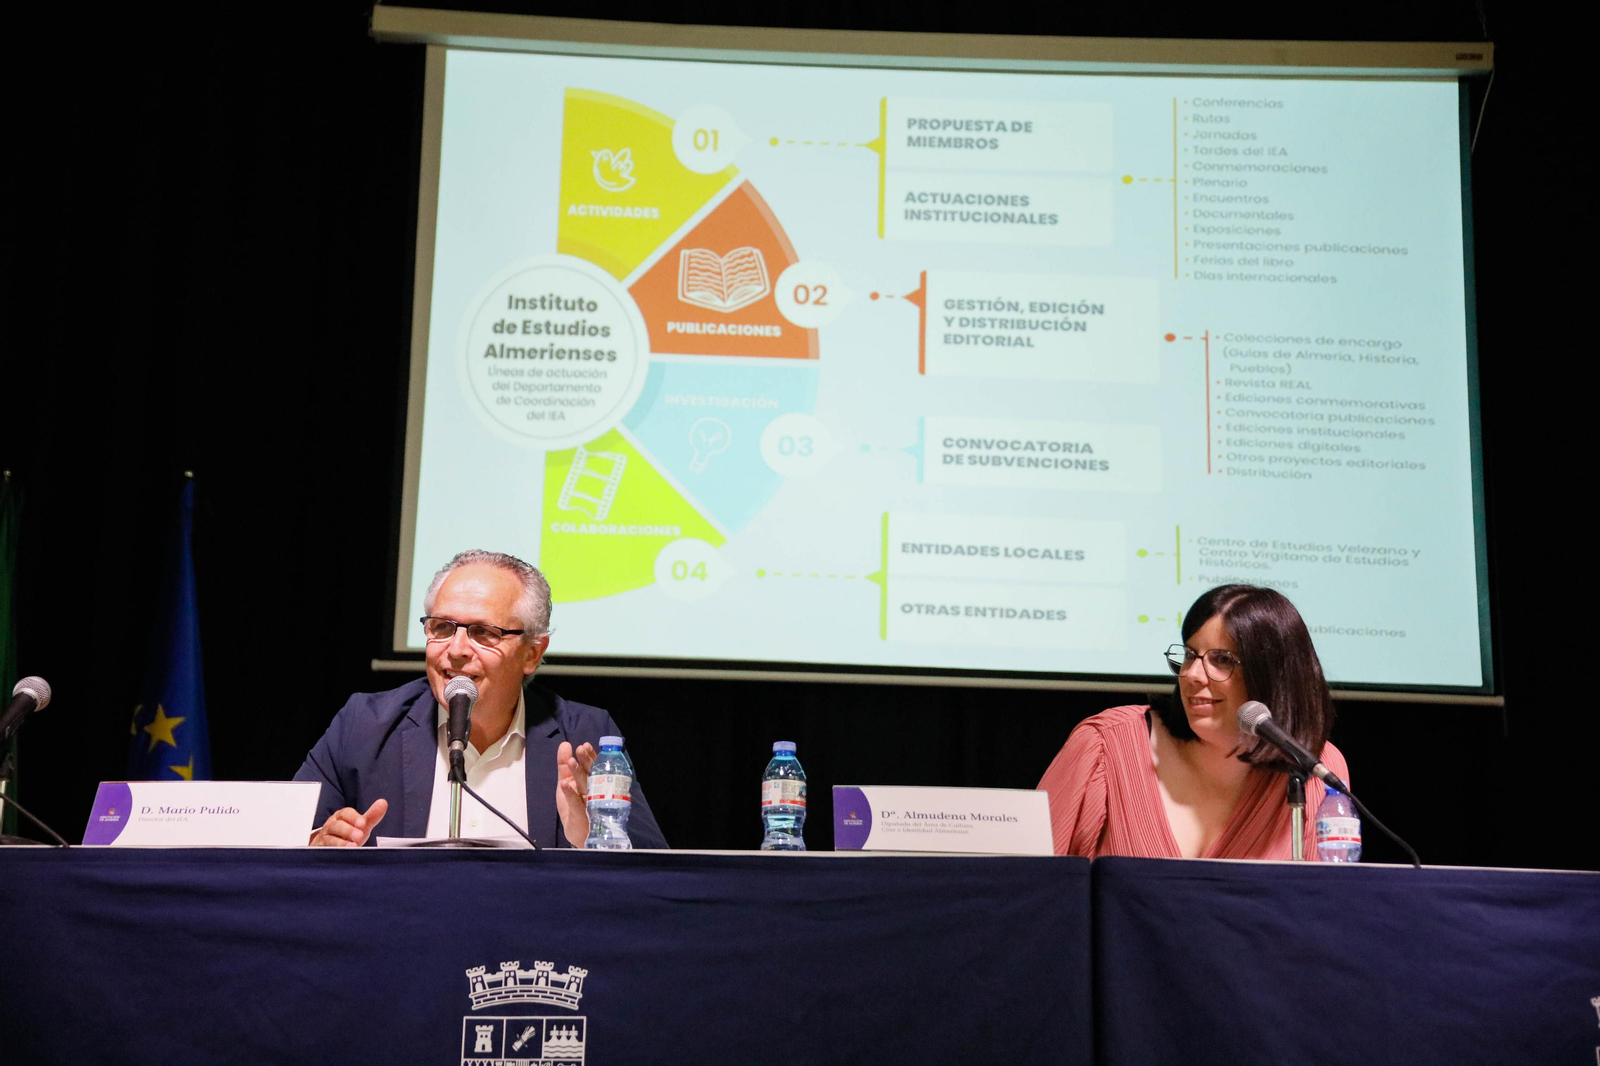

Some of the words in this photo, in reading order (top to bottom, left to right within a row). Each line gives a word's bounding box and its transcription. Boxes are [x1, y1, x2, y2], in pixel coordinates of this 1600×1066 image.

[1192, 98, 1284, 109] Conferencias
[907, 117, 1008, 133] PROPUESTA
[1011, 121, 1033, 133] DE
[1192, 114, 1230, 124] Rutas
[693, 129, 719, 151] 01
[907, 136, 999, 150] MIEMBROS
[1192, 130, 1257, 141] Jornadas
[1192, 146, 1239, 156] Tardes
[1243, 146, 1264, 156] del
[1267, 147, 1288, 156] IEA
[1192, 162, 1328, 174] Conmemoraciones
[1193, 177, 1247, 188] Plenario
[904, 192, 1030, 207] ACTUACIONES
[1193, 193, 1269, 204] Encuentros
[568, 204, 660, 219] ACTIVIDADES
[904, 209, 1059, 225] INSTITUCIONALES
[1193, 209, 1295, 221] Documentales
[1193, 225, 1281, 236] Exposiciones
[1193, 240, 1300, 253] Presentaciones
[1304, 242, 1408, 256] publicaciones
[1193, 255, 1234, 266] Ferias
[1237, 256, 1259, 267] del
[1263, 256, 1294, 268] libro
[1227, 272, 1337, 284] internacionales
[793, 284, 828, 306] 02
[507, 294, 598, 312] Instituto
[944, 296, 1024, 314] GESTIÓN,
[1029, 299, 1105, 316] EDICIÓN
[492, 319, 517, 334] de
[522, 319, 611, 337] Estudios
[667, 321, 782, 337] PUBLICACIONES
[944, 316, 955, 327] Y
[958, 316, 1087, 332] DISTRIBUCIÓN
[943, 334, 1035, 348] EDITORIAL
[1223, 332, 1312, 345] Colecciones
[1315, 334, 1335, 346] de
[1338, 337, 1402, 351] encargo
[483, 343, 617, 362] Almerienses
[1272, 349, 1292, 360] de
[488, 364, 524, 377] Líneas
[527, 365, 543, 377] de
[545, 366, 608, 379] actuación
[1230, 362, 1292, 376] Pueblos)
[492, 381, 510, 391] del
[513, 381, 601, 394] Departamento
[1225, 377, 1276, 389] Revista
[1279, 380, 1312, 390] REAL
[496, 394, 511, 405] de
[513, 395, 596, 407] Coordinación
[664, 394, 779, 409] INVESTIGACIÓN
[1225, 393, 1293, 405] Ediciones
[1296, 396, 1426, 411] conmemorativas
[526, 410, 545, 421] del
[548, 411, 566, 421] IEA
[1225, 407, 1324, 422] Convocatoria
[1328, 412, 1435, 426] publicaciones
[1226, 422, 1293, 435] Ediciones
[1297, 425, 1406, 440] institucionales
[778, 436, 813, 456] 03
[942, 437, 1094, 454] CONVOCATORIA
[1226, 437, 1294, 450] Ediciones
[1297, 440, 1361, 454] digitales
[942, 454, 964, 465] DE
[967, 454, 1110, 471] SUBVENCIONES
[1226, 452, 1264, 463] Otros
[1268, 454, 1342, 468] proyectos
[1346, 457, 1426, 471] editoriales
[1227, 466, 1312, 480] Distribución
[550, 522, 682, 536] COLABORACIONES
[901, 542, 1000, 557] ENTIDADES
[1004, 546, 1085, 561] LOCALES
[1197, 537, 1245, 548] Centro
[1250, 539, 1268, 549] de
[1272, 540, 1333, 553] Estudios
[1411, 549, 1421, 559] y
[1199, 547, 1248, 559] Centro
[1252, 549, 1319, 564] Virgitano
[1322, 552, 1341, 563] de
[1345, 554, 1409, 566] Estudios
[671, 560, 708, 581] 04
[900, 603, 961, 616] OTRAS
[964, 605, 1067, 621] ENTIDADES
[1308, 624, 1407, 638] ublicaciones
[140, 806, 154, 815] D.
[157, 806, 196, 815] Mario
[199, 806, 240, 815] Pulido
[903, 811, 967, 821] Almudena
[970, 813, 1018, 823] Morales
